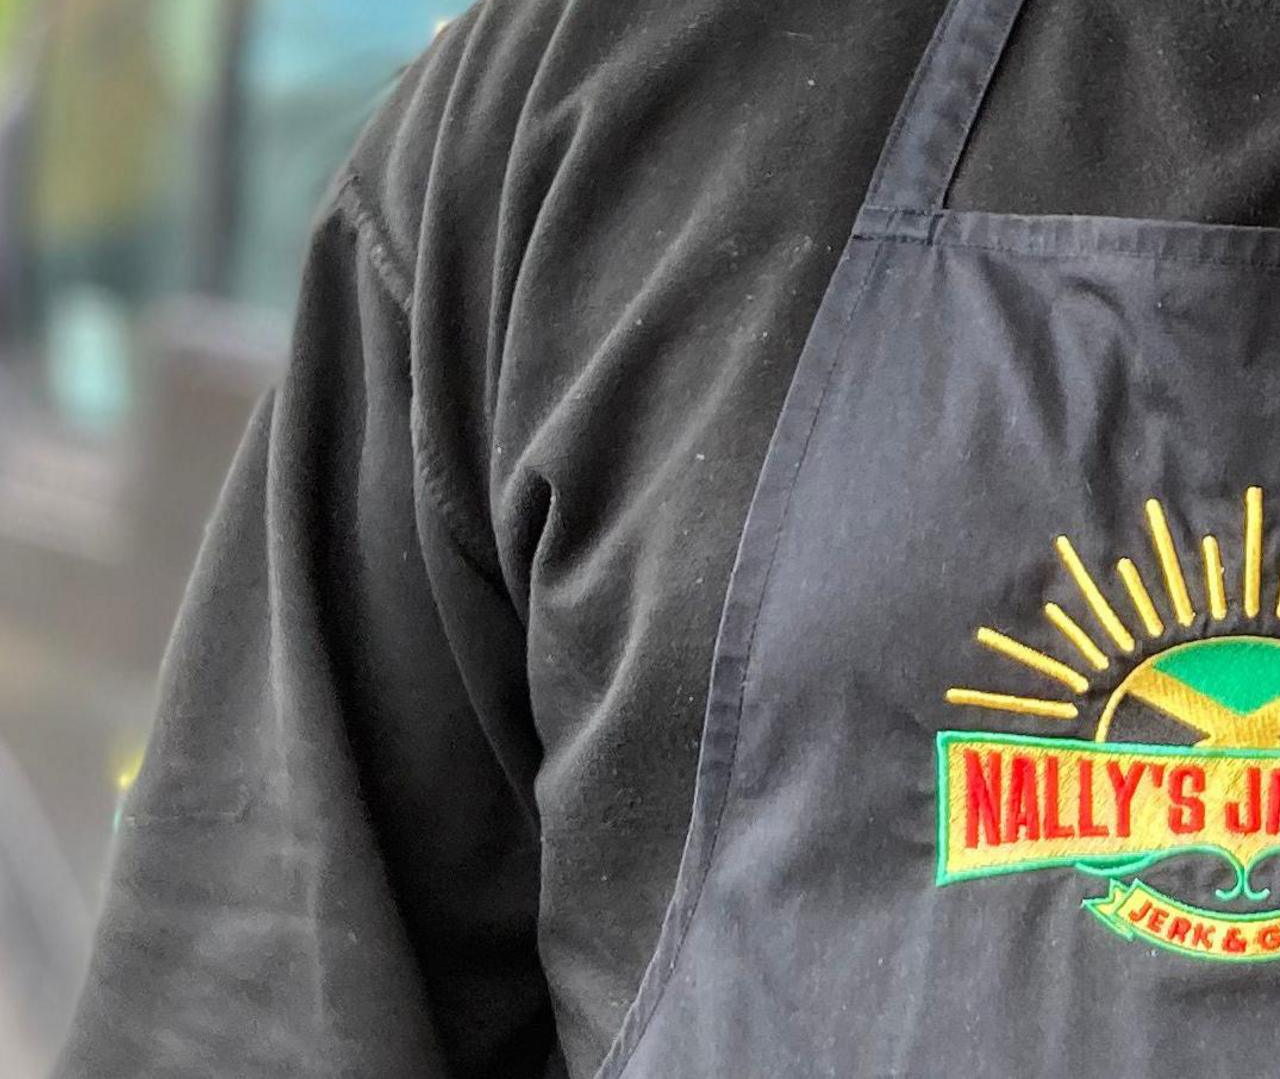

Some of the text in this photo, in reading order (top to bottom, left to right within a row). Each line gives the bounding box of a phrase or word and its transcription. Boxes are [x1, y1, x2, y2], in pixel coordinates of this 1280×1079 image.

[964, 749, 1206, 849] NALLY'S
[1127, 899, 1214, 951] JERK
[1222, 927, 1249, 953] &
